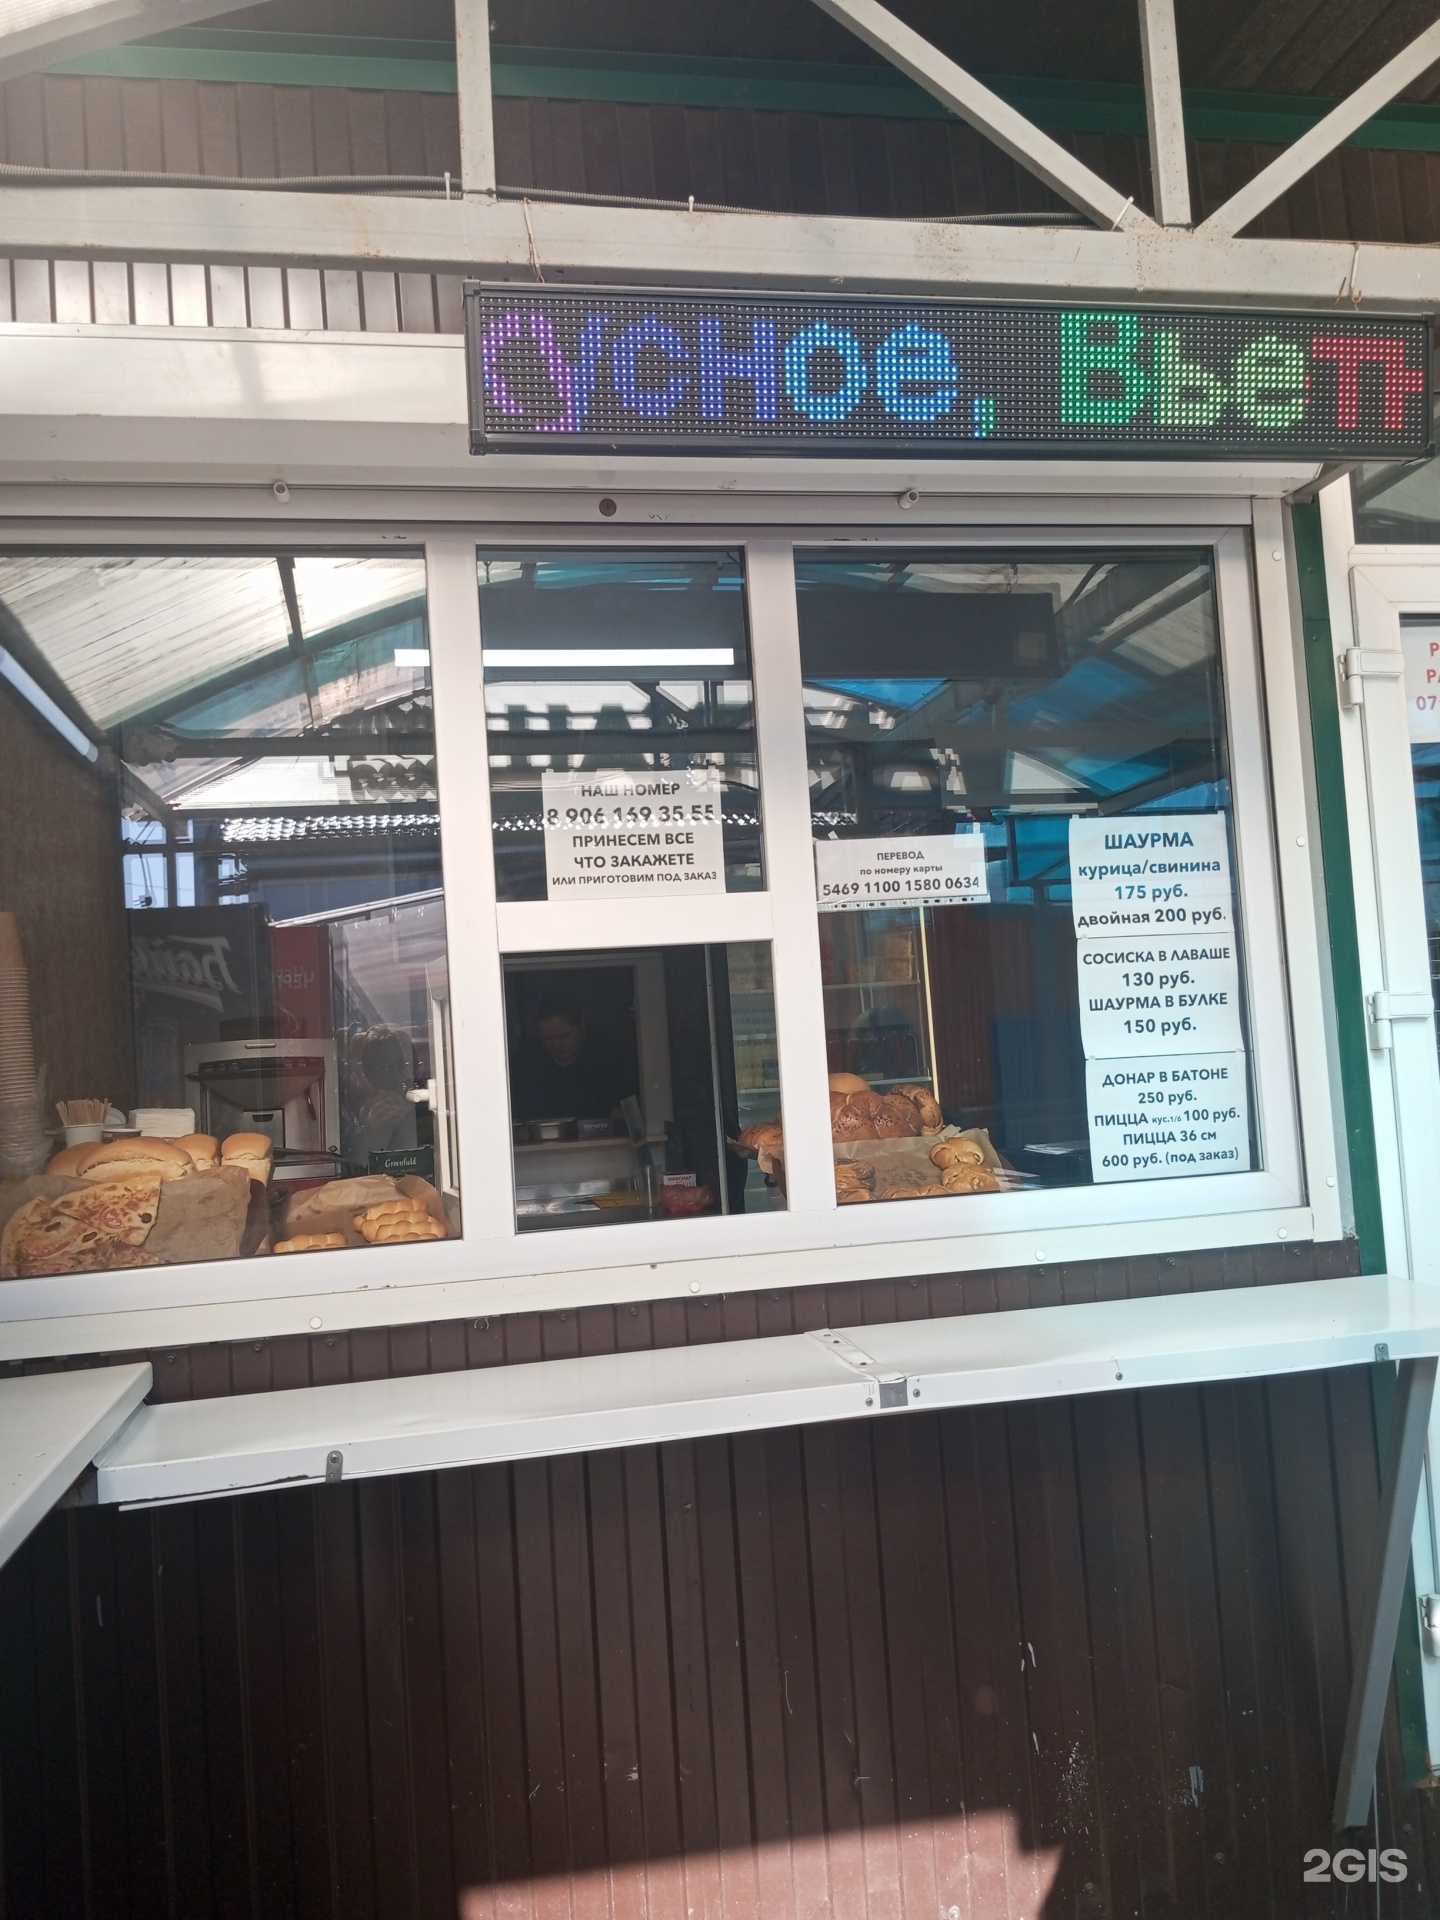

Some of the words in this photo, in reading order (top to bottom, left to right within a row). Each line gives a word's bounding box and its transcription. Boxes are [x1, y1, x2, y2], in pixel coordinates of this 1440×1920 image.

[581, 784, 618, 797] НАШ
[624, 783, 680, 797] НОМЕР
[547, 808, 558, 825] 8
[565, 807, 605, 825] 906
[613, 806, 651, 823] 169
[658, 805, 684, 822] 35
[691, 804, 714, 821] 55
[573, 833, 660, 848] ПРИНЕСЕМ
[665, 832, 694, 845] ВСЕ
[1105, 832, 1194, 850] ШАУРМА
[574, 856, 606, 869] ЧТО
[611, 853, 695, 868] ЗАКАЖЕТЕ
[877, 851, 925, 861] ПЕРЕВОД
[552, 877, 576, 886] ИЛИ
[579, 874, 654, 885] ПРИГОТОВИМ
[657, 873, 682, 883] ПОД
[684, 871, 717, 881] ЗАКАЗ
[860, 868, 872, 876] по
[875, 866, 911, 876] номеру
[913, 864, 943, 875] карты
[1078, 859, 1221, 880] курица/свинина
[823, 883, 860, 896] 5469
[864, 880, 900, 894] 1100
[905, 878, 941, 892] 1580
[945, 876, 979, 889] 0634
[1115, 885, 1146, 900] 175
[1152, 884, 1189, 902] руб.
[1077, 911, 1150, 928] двойная
[1154, 908, 1187, 923] 200
[1192, 907, 1226, 925] руб.
[1083, 951, 1155, 965] СОСИСКА
[1158, 950, 1167, 962] В
[1170, 947, 1231, 962] ЛАВАШЕ
[1122, 972, 1154, 987] 130
[1159, 970, 1195, 989] руб.
[1089, 996, 1161, 1012] ШАУРМА
[1165, 995, 1175, 1008] В
[1178, 992, 1228, 1007] БУЛКЕ
[1124, 1018, 1156, 1034] 150
[1161, 1017, 1197, 1036] руб.
[1102, 1072, 1155, 1088] ДОНАР
[1159, 1071, 1168, 1083] В
[1171, 1068, 1228, 1082] БАТОНЕ
[1137, 1092, 1164, 1104] 250
[1168, 1090, 1197, 1105] руб.
[1094, 1112, 1148, 1127] ПИЦЦА
[1183, 1109, 1209, 1121] 100
[1213, 1107, 1240, 1122] руб.
[1123, 1130, 1176, 1145] ПИЦЦА
[1180, 1129, 1197, 1142] 36
[1201, 1131, 1217, 1140] см
[1102, 1155, 1129, 1167] 600
[1133, 1153, 1162, 1169] руб.
[1165, 1151, 1197, 1165] (под
[1199, 1146, 1239, 1161] заказ)
